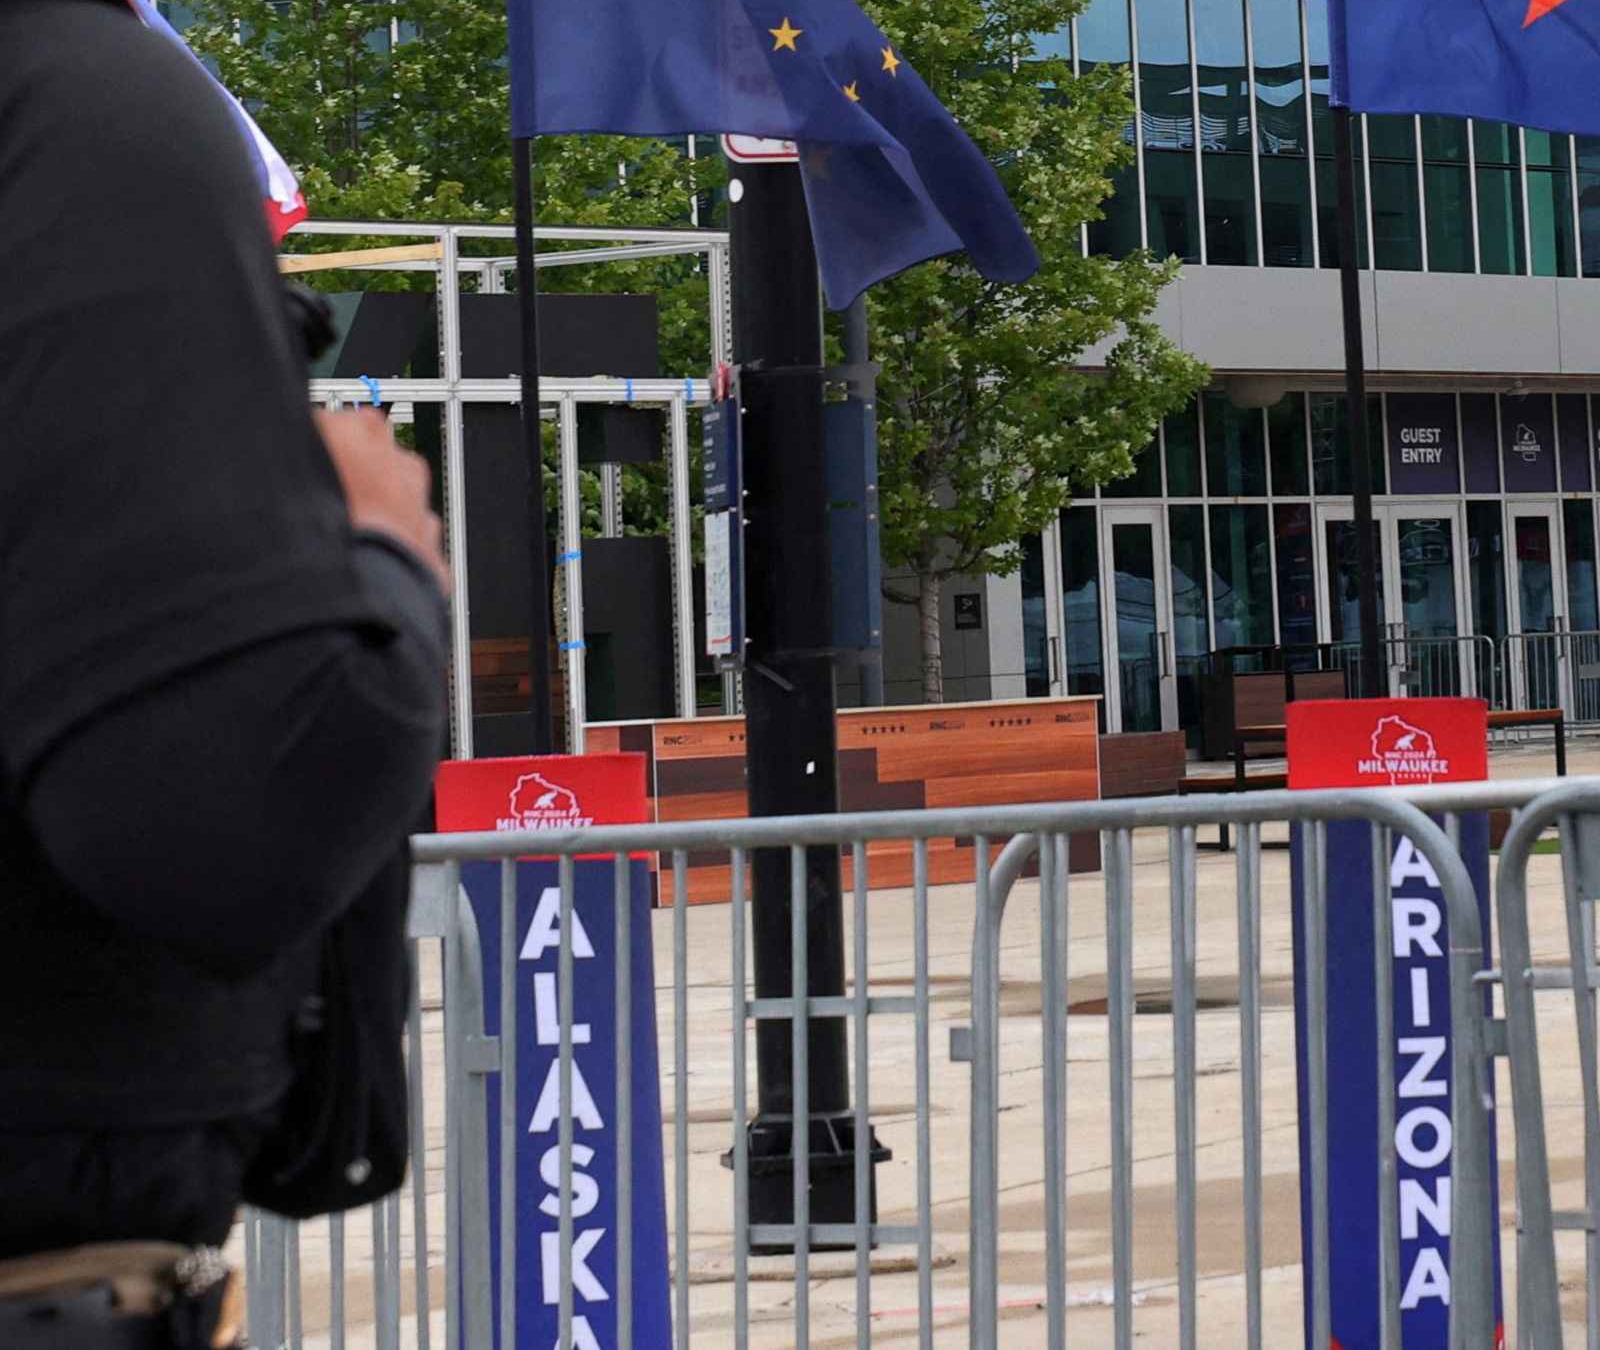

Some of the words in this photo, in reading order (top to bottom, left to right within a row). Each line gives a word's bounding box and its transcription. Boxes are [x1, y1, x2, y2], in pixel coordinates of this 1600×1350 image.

[1401, 428, 1441, 443] GUEST
[1401, 448, 1442, 463] ENTRY
[1358, 760, 1448, 773] MILWAUKEE
[496, 817, 593, 830] MILWAUKEE
[1390, 835, 1453, 1310] ARIZONA
